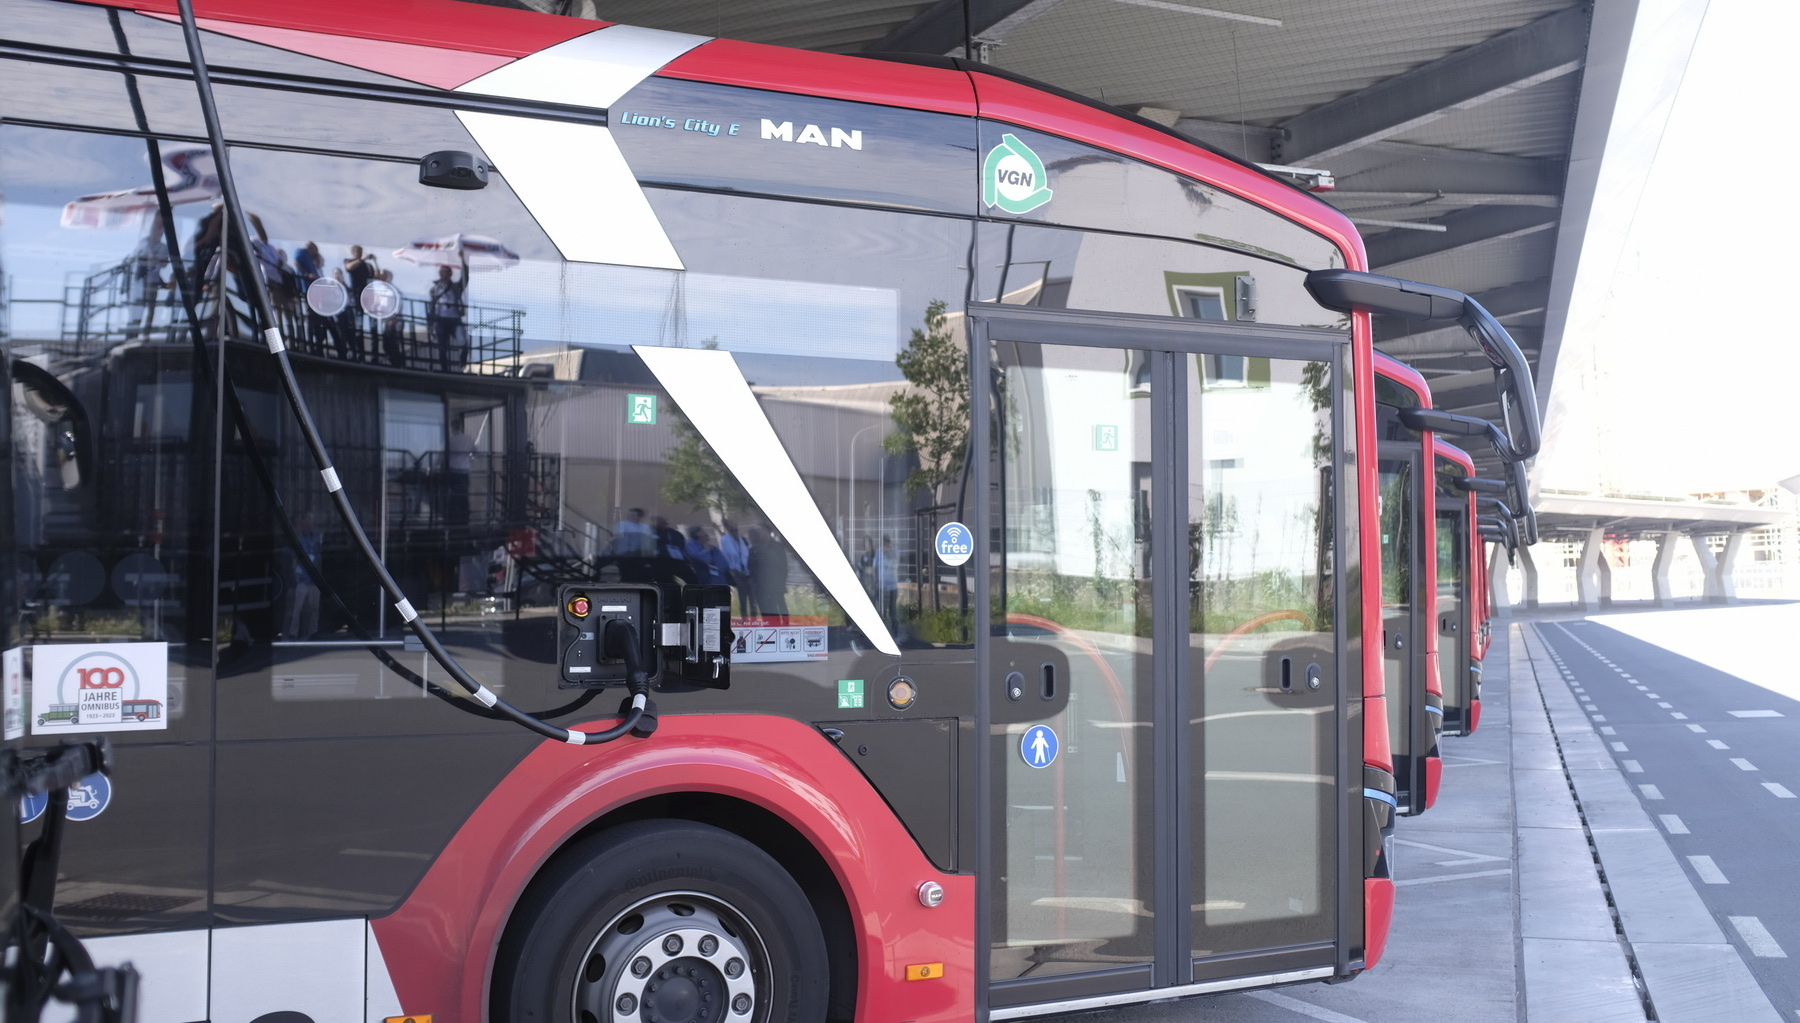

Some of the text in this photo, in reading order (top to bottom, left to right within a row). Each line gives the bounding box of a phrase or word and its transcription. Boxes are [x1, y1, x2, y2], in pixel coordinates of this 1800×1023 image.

[620, 111, 741, 137] Lion's City E
[760, 118, 862, 150] MAN
[997, 168, 1033, 187] VGN
[941, 540, 968, 554] free
[77, 667, 125, 689] 100
[83, 691, 118, 702] JAHRE
[81, 702, 120, 711] OMNIBUS
